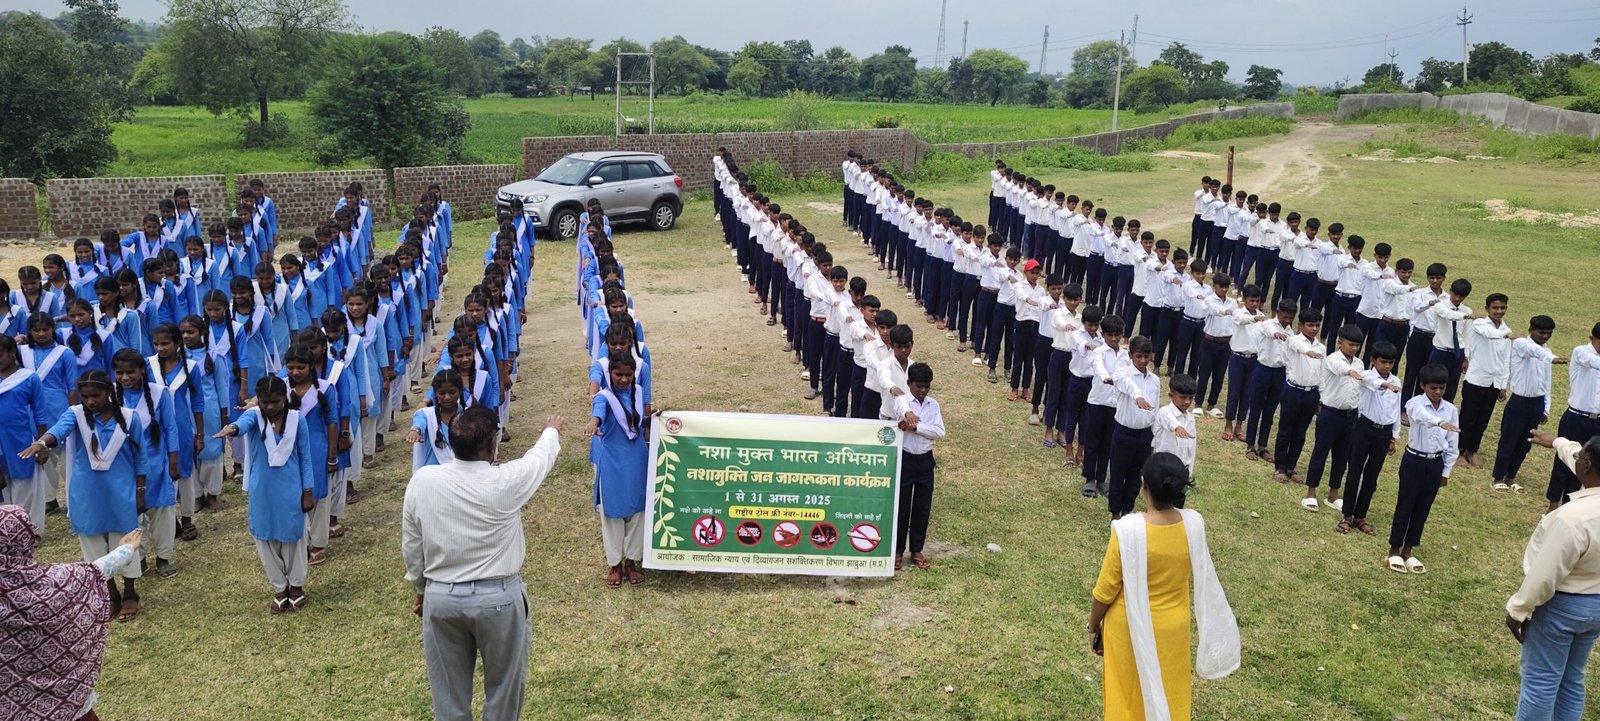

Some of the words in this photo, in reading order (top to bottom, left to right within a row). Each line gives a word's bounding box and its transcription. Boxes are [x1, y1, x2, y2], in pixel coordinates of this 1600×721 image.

[698, 445, 731, 460] नशा
[737, 447, 774, 466] मुक्त
[780, 447, 819, 464] भारत
[825, 447, 888, 466] अभियान
[687, 465, 748, 487] नशामुक्ति
[751, 470, 773, 483] जन
[776, 472, 841, 487] जागरूकता
[843, 471, 891, 489] कार्यक्रम
[725, 491, 730, 502] 1
[735, 490, 746, 502] से
[750, 493, 762, 503] 31
[768, 494, 800, 504] अगस्त
[804, 495, 831, 505] 2025
[691, 506, 701, 514] को
[755, 508, 769, 517] टोल
[771, 509, 781, 517] फ्री
[656, 551, 685, 561] आयोजक
[692, 553, 722, 563] सामाजिक
[724, 555, 740, 563] न्याय
[741, 554, 751, 565] एवं
[752, 554, 784, 565] दिव्यांगजन
[786, 555, 824, 566] सशक्तिकरण
[826, 556, 844, 567] विभाग
[846, 559, 867, 569] झाबुआ
